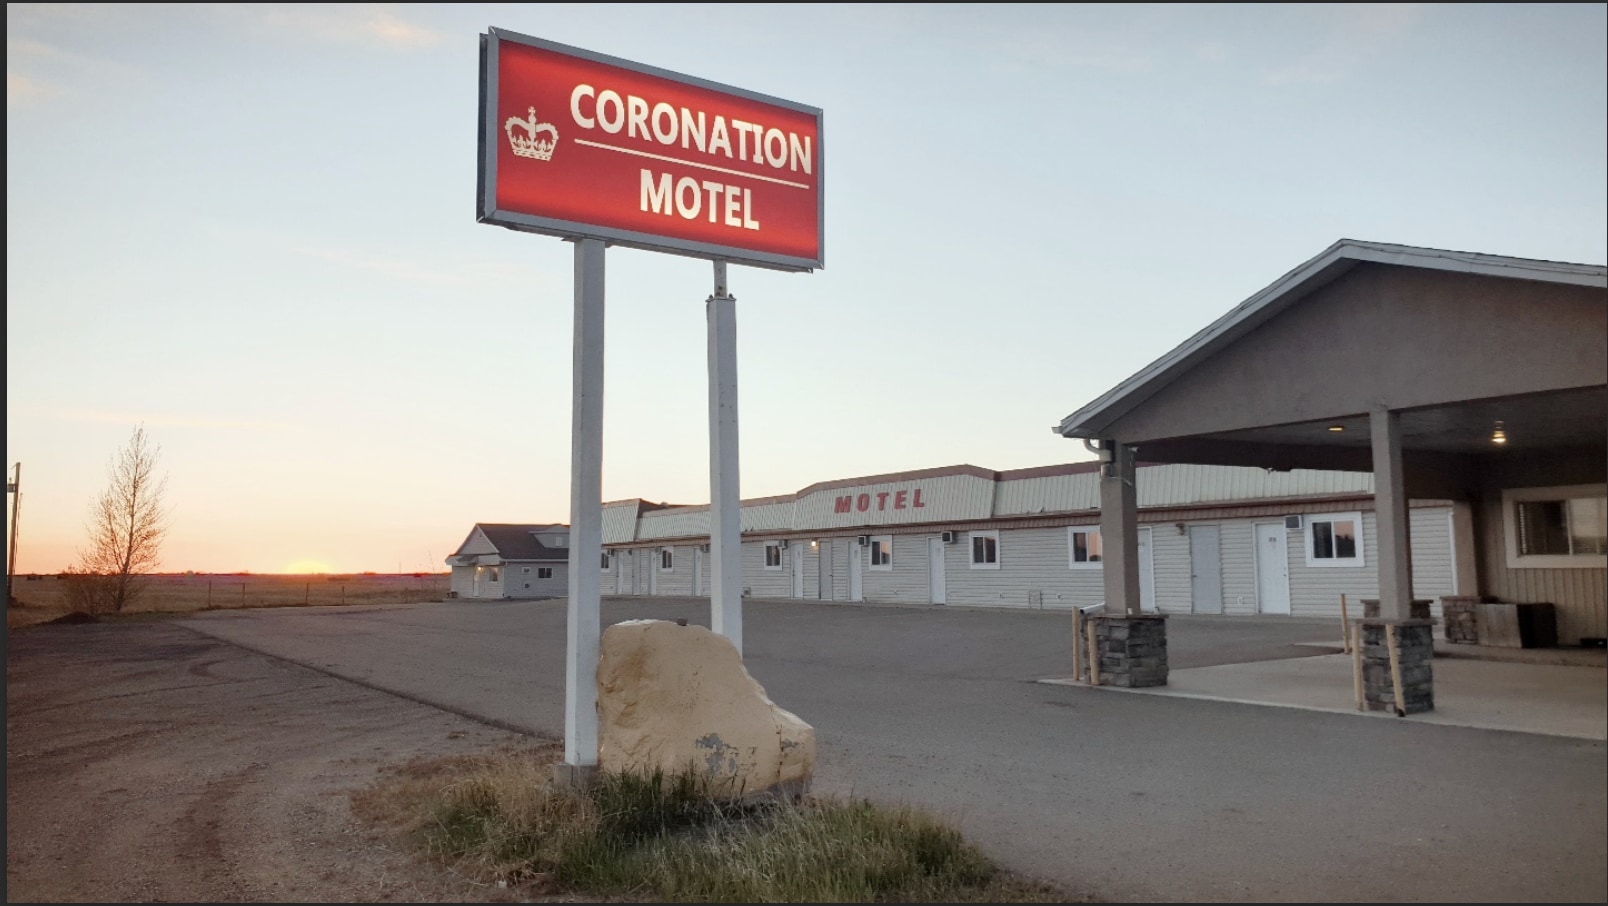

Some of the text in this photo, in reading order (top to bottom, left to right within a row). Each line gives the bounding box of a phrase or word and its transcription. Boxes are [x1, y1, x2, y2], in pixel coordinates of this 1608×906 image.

[570, 84, 812, 175] CORONATION
[640, 168, 760, 231] MOTEL
[834, 489, 925, 513] MOTEL
